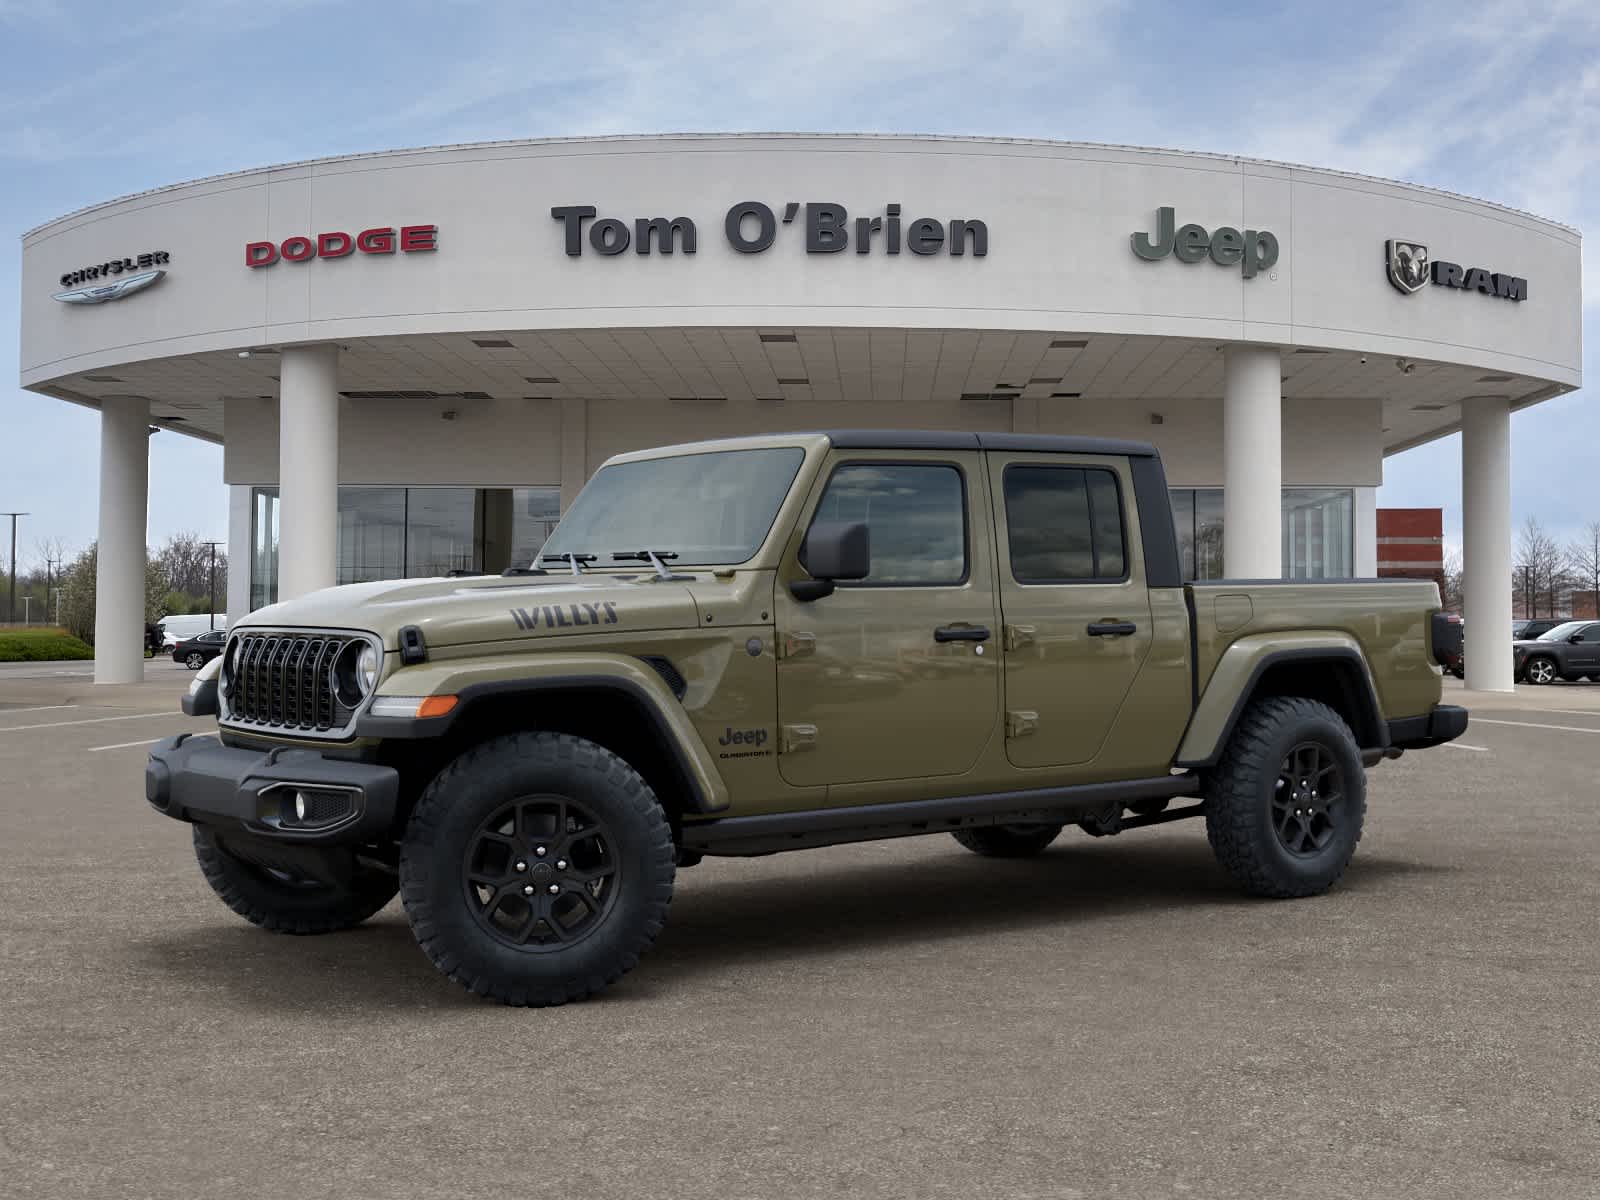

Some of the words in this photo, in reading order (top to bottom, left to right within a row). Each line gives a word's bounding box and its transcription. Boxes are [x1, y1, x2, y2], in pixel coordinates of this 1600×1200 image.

[245, 224, 438, 268] DODGE
[551, 205, 697, 256] Tom
[725, 201, 989, 256] O'Brien
[1130, 206, 1280, 279] Jeep
[60, 250, 170, 287] CHRYSLER
[1431, 261, 1528, 301] RAM
[510, 602, 618, 630] WILLYS
[719, 727, 768, 747] Jeep
